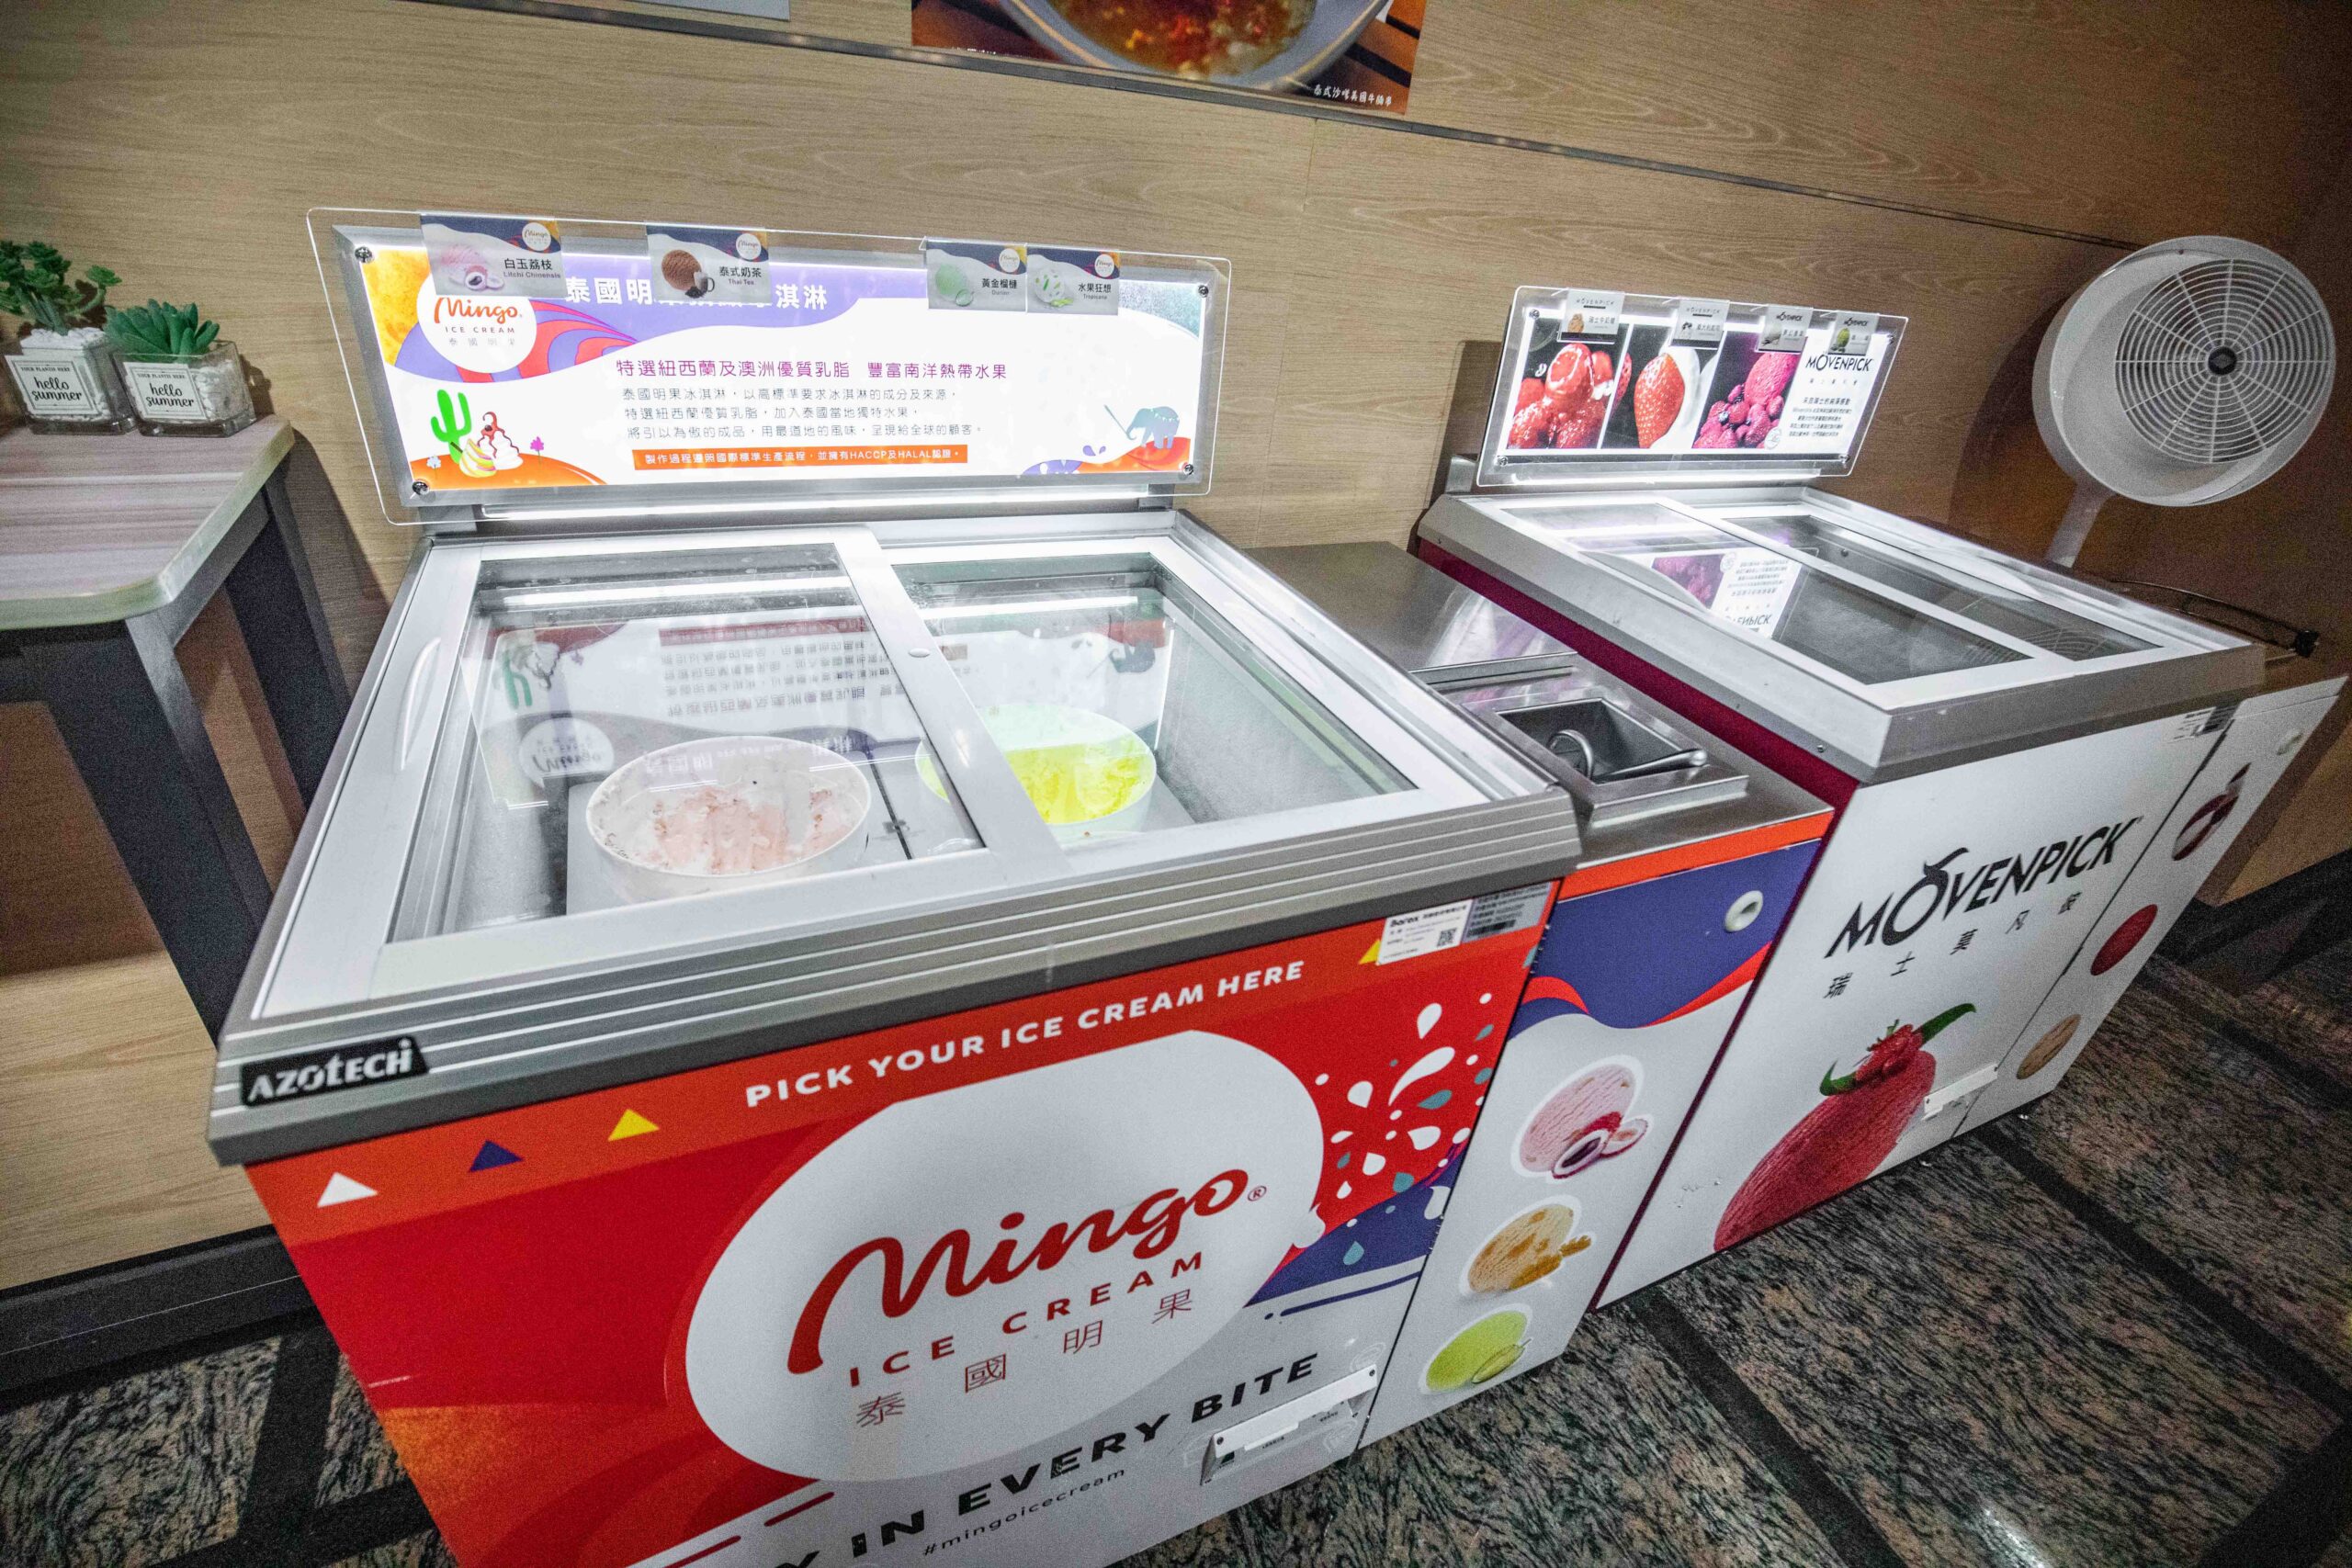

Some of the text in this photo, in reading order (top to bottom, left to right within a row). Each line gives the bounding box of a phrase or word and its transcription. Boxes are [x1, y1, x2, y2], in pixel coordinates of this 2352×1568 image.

[504, 258, 553, 270] 白玉荔枝
[719, 265, 763, 277] 泰式奶茶
[1078, 283, 1112, 293] 水果狂想
[616, 360, 1007, 378] 特選紐西蘭及澳洲優質乳脂 豐富南洋熱帶水果
[34, 376, 70, 390] hello
[149, 382, 183, 397] hello
[31, 389, 82, 401] summer
[145, 396, 195, 408] summer
[745, 960, 1305, 1107] PICK YOUR ICE CREAM HERE
[850, 1252, 1203, 1388] ICE CREAM
[856, 1288, 1193, 1427] 泰國明果
[851, 1354, 1318, 1558] IN EVERY BITE
[922, 1469, 1125, 1557] #mingoicecream
